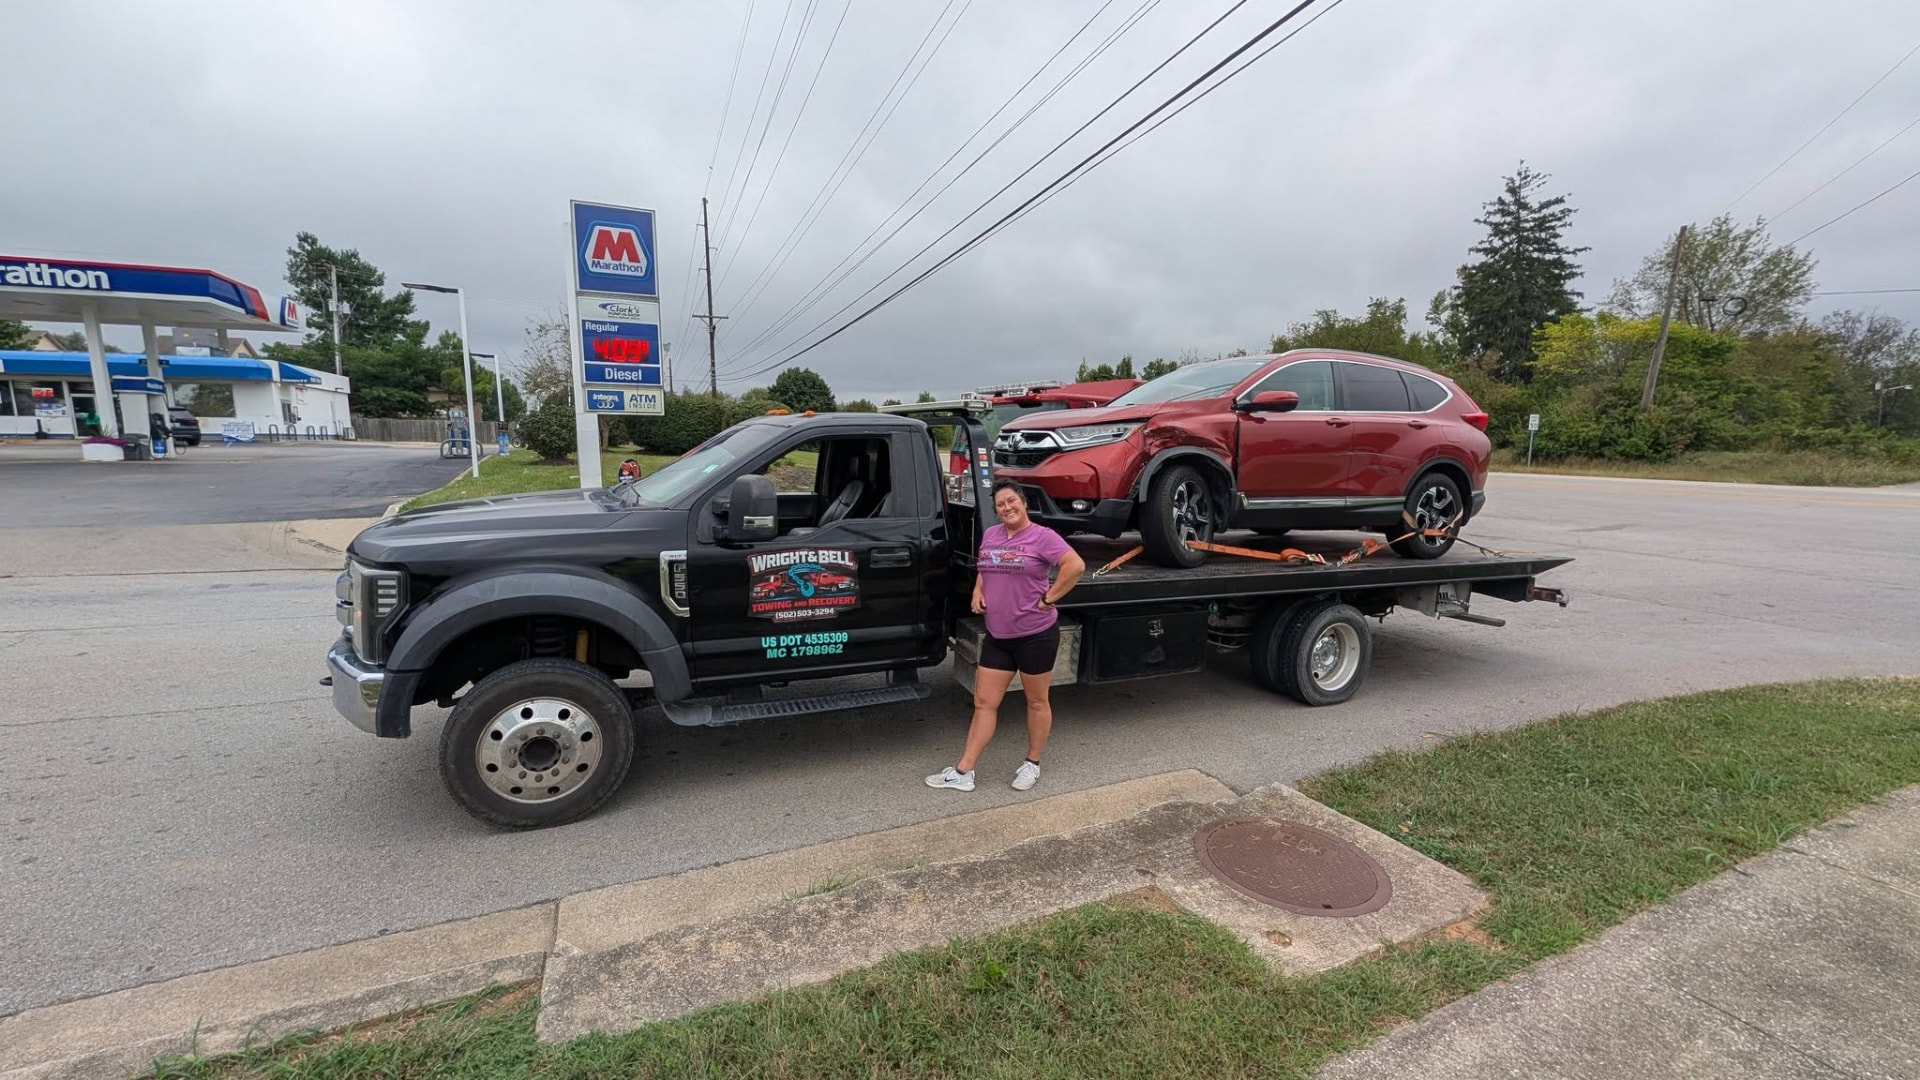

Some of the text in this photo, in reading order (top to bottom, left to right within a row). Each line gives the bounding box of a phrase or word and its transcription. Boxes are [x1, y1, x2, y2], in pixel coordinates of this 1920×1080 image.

[591, 260, 643, 274] Marathon
[585, 321, 619, 332] Regular
[605, 367, 642, 380] Diesel
[629, 394, 656, 403] ATM
[752, 600, 791, 612] TOWING
[808, 596, 856, 607] RECOVERY
[761, 632, 848, 648] US DOT 4535309
[766, 644, 843, 659] MC 1798962
